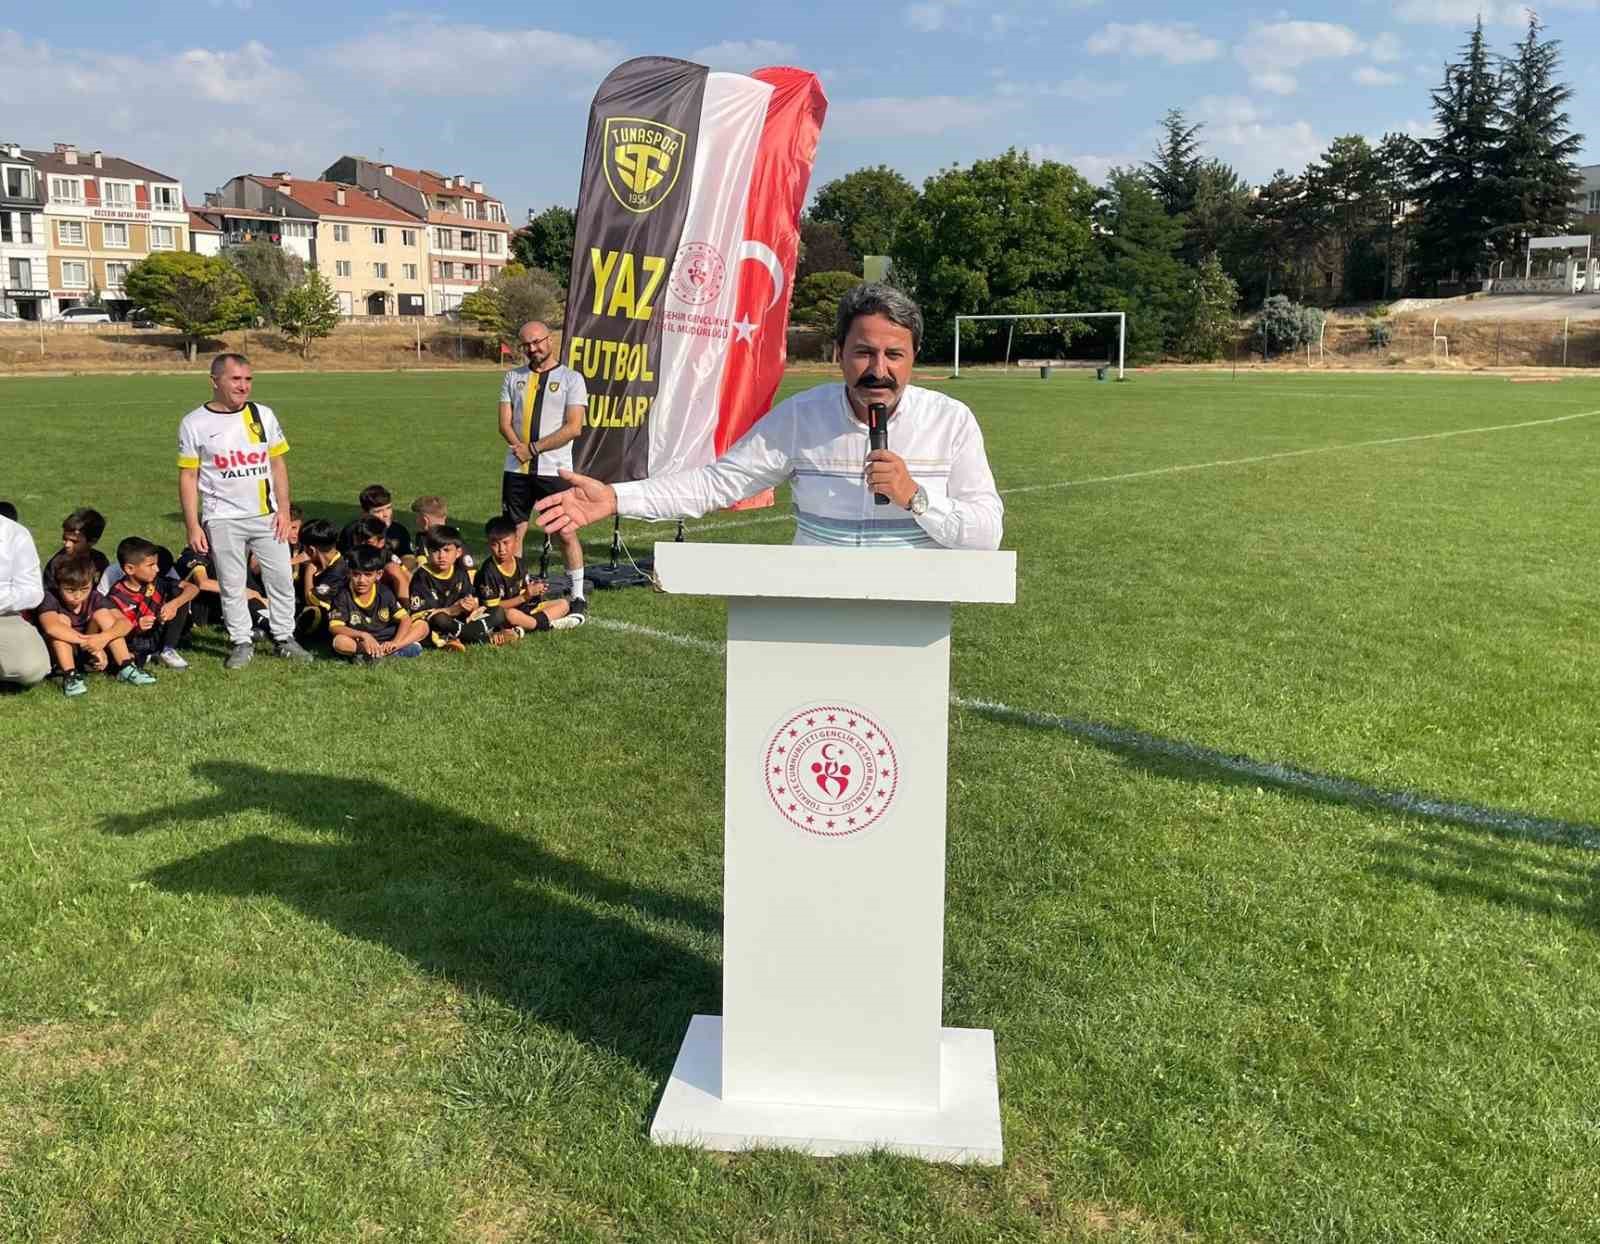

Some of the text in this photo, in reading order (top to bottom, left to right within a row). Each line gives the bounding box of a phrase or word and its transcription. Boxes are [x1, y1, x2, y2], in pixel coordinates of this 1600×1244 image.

[611, 127, 679, 155] TUNASPOR
[591, 247, 666, 320] YAZ
[569, 336, 654, 382] FUTBOL
[582, 394, 654, 428] ULLAR
